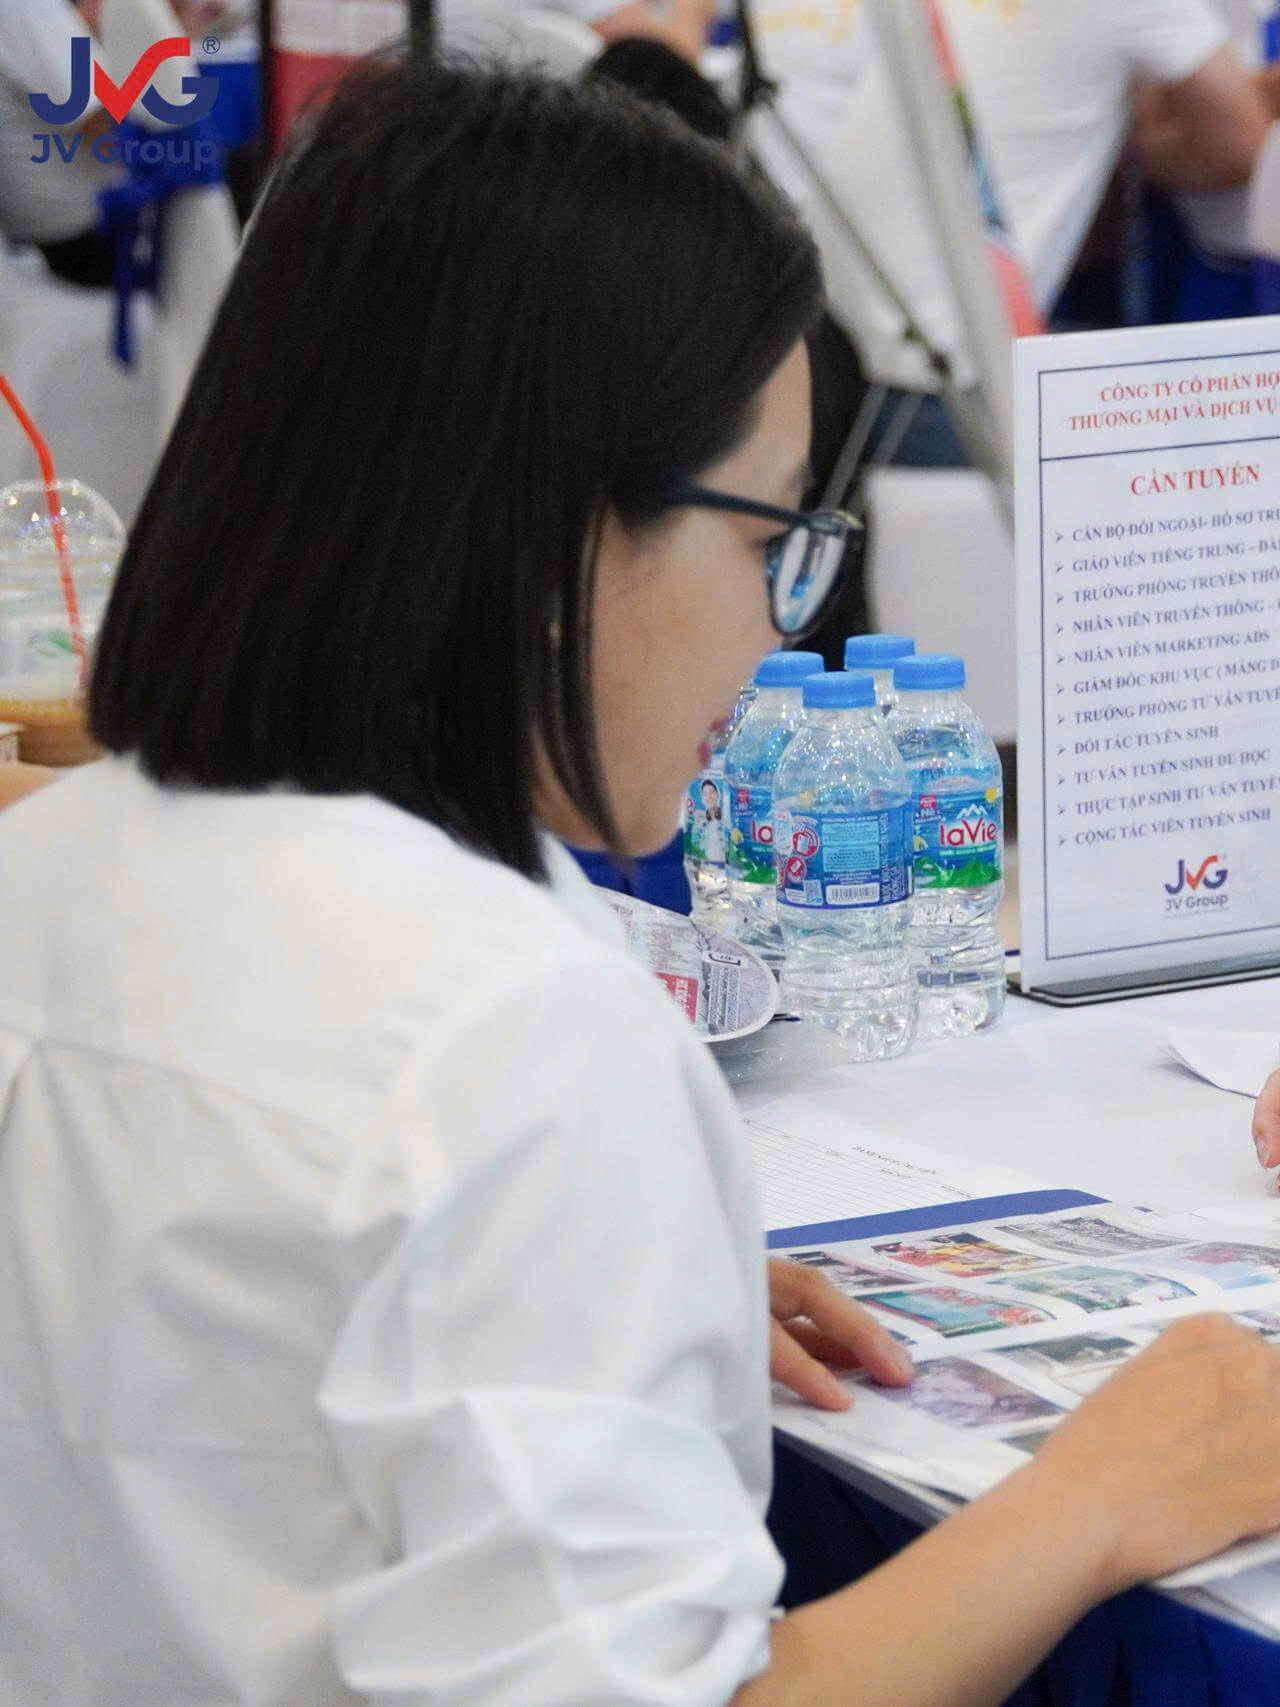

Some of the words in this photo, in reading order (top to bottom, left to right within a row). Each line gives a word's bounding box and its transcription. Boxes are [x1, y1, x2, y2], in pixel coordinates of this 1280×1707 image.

[1100, 382, 1148, 401] CÔNG
[1153, 381, 1173, 397] TY
[1069, 410, 1142, 431] THƯƠNG
[1145, 406, 1178, 425] MẠI
[1183, 401, 1205, 418] VÀ
[1210, 400, 1251, 419] DỊCH
[1255, 397, 1278, 415] VỤ
[1197, 542, 1245, 559] TRUNG
[1154, 633, 1240, 654] MARKETING
[1243, 630, 1270, 644] ADS
[1148, 670, 1180, 685] KHU
[1104, 734, 1132, 750] TÁC
[1185, 725, 1219, 739] SINH
[1181, 755, 1214, 771] SINH
[1148, 789, 1181, 804] SINH
[1120, 822, 1147, 839] TÁC
[1237, 807, 1271, 822] SINH
[1165, 897, 1183, 912] JV
[1185, 894, 1229, 909] Group
